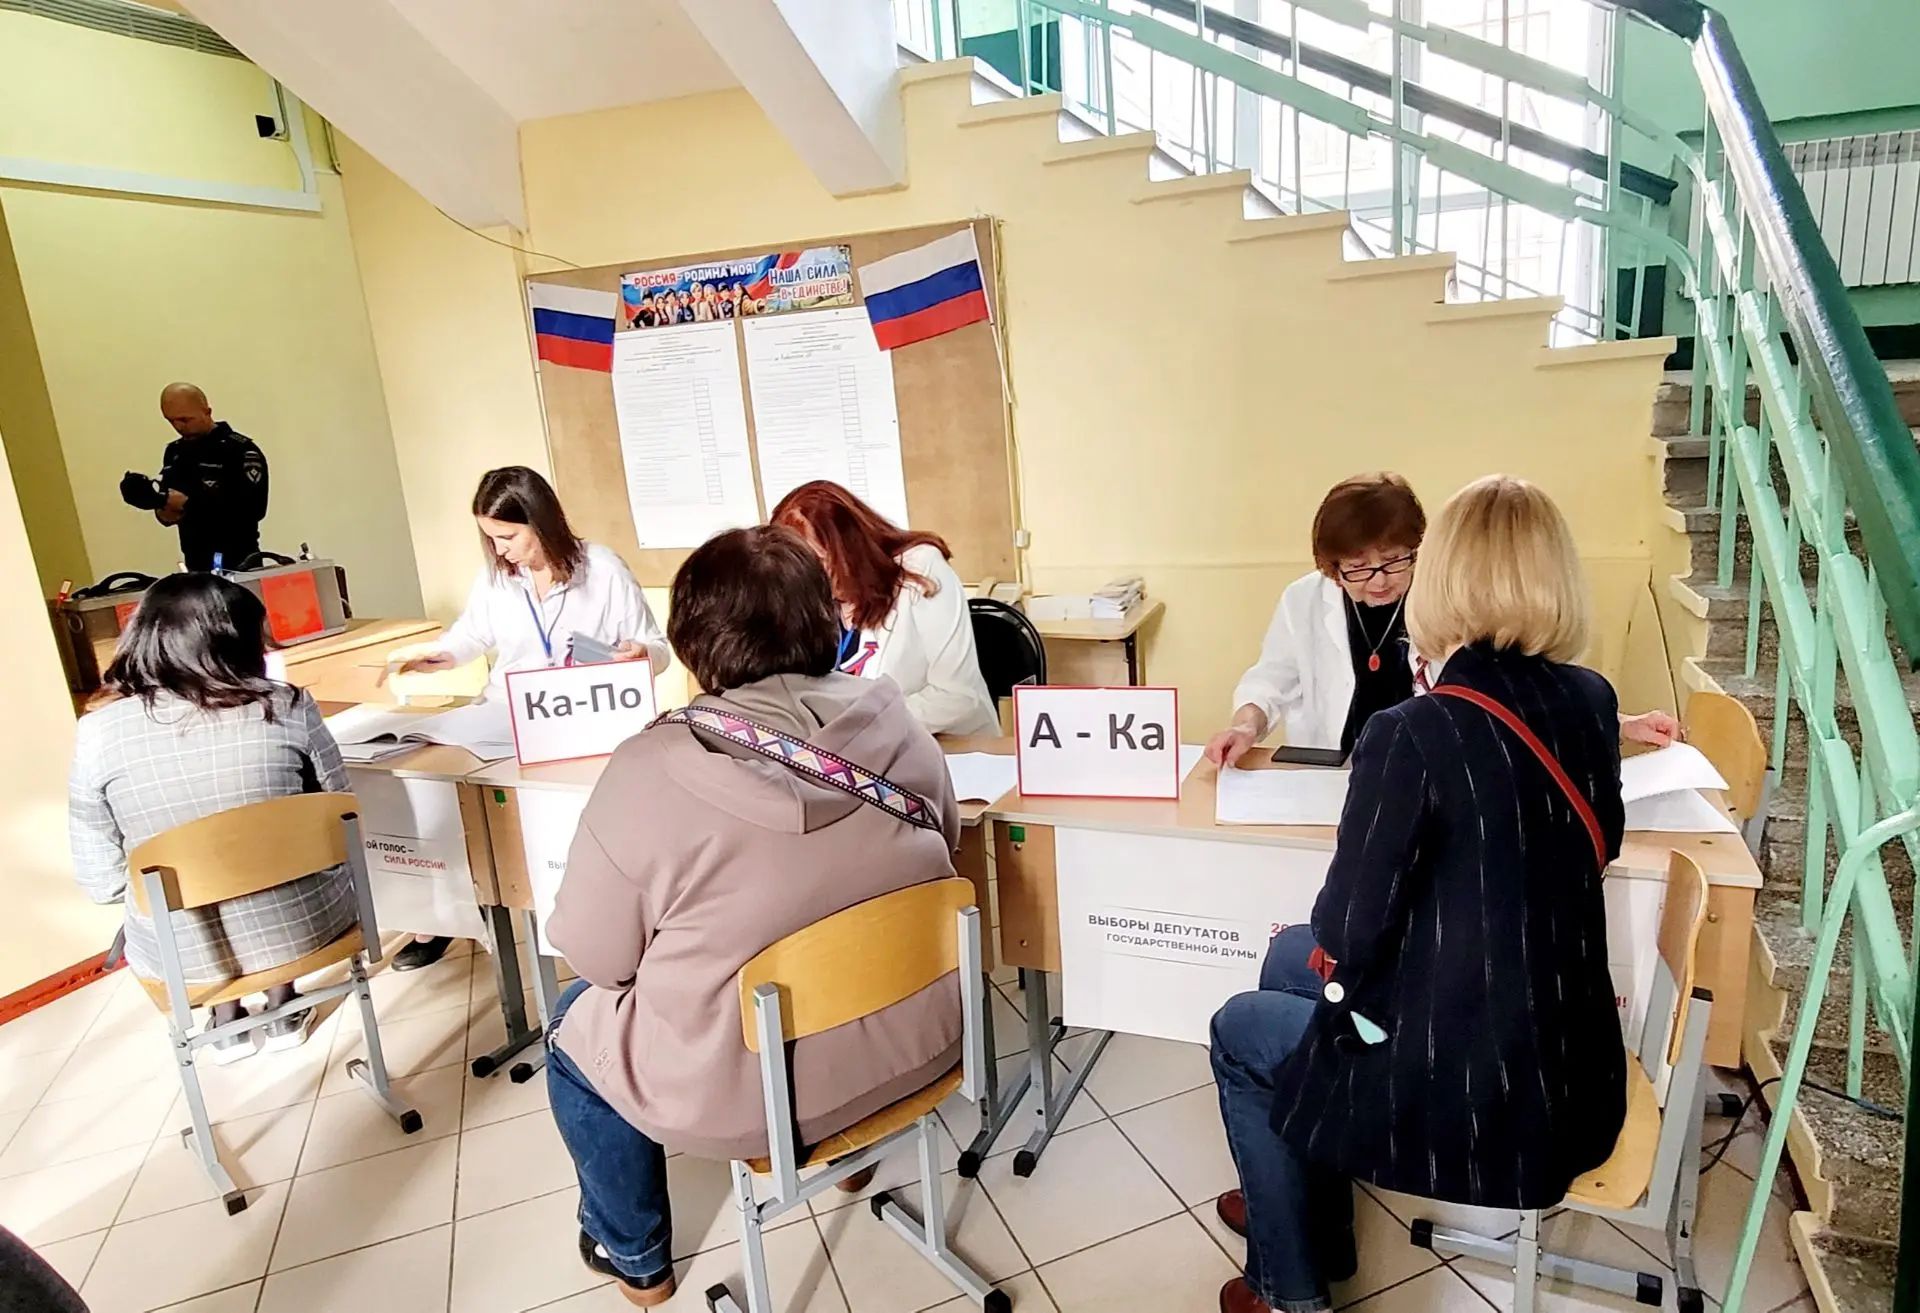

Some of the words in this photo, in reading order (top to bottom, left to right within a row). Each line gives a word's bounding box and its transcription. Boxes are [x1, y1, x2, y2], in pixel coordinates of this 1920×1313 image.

[634, 272, 677, 287] РОССИЯ
[684, 267, 729, 283] РОДИНА
[729, 262, 757, 277] МОЯ!
[769, 268, 802, 285] НАША
[807, 264, 838, 280] СИЛА
[792, 279, 848, 299] ЕДИНСТВЕ!
[524, 682, 642, 721] Ка-По
[1029, 712, 1062, 749] А
[1108, 713, 1165, 750] Ка
[365, 839, 379, 850] ОЙ
[379, 842, 407, 854] ГОЛОС
[384, 855, 407, 865] СИЛА
[408, 857, 447, 871] РОССИИ!
[1088, 914, 1150, 931] ВЫБОРЫ
[1153, 922, 1240, 942] ДЕПУТАТОВ
[1106, 933, 1218, 955] ГОСУДАРСТВЕННОЙ
[1221, 947, 1257, 960] ДУМЫ
